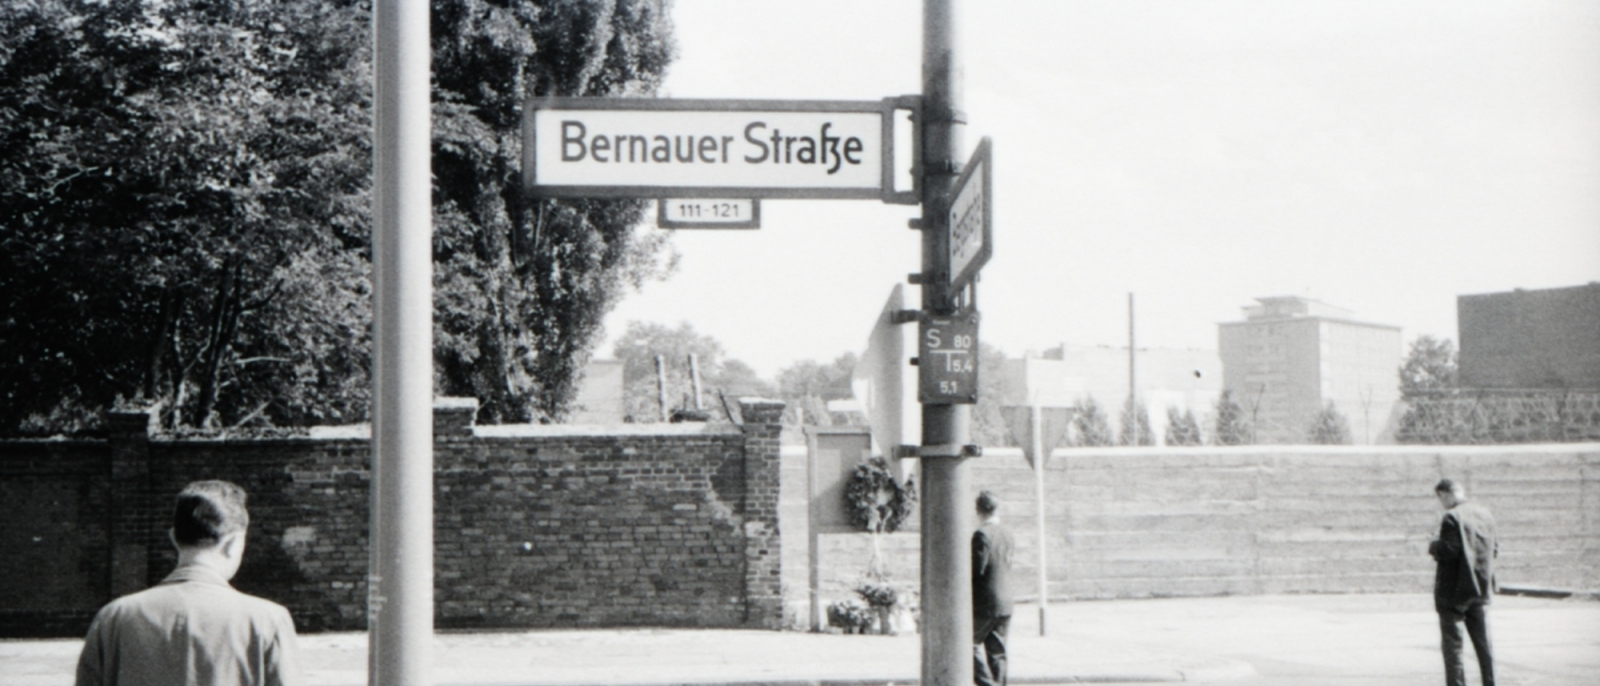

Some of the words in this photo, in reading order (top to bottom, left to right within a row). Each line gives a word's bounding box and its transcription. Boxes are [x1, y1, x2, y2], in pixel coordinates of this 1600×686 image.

[560, 120, 734, 163] Bernauer
[743, 121, 864, 175] Straße
[679, 203, 739, 218] 111-121
[926, 328, 941, 348] S
[953, 334, 971, 349] 80
